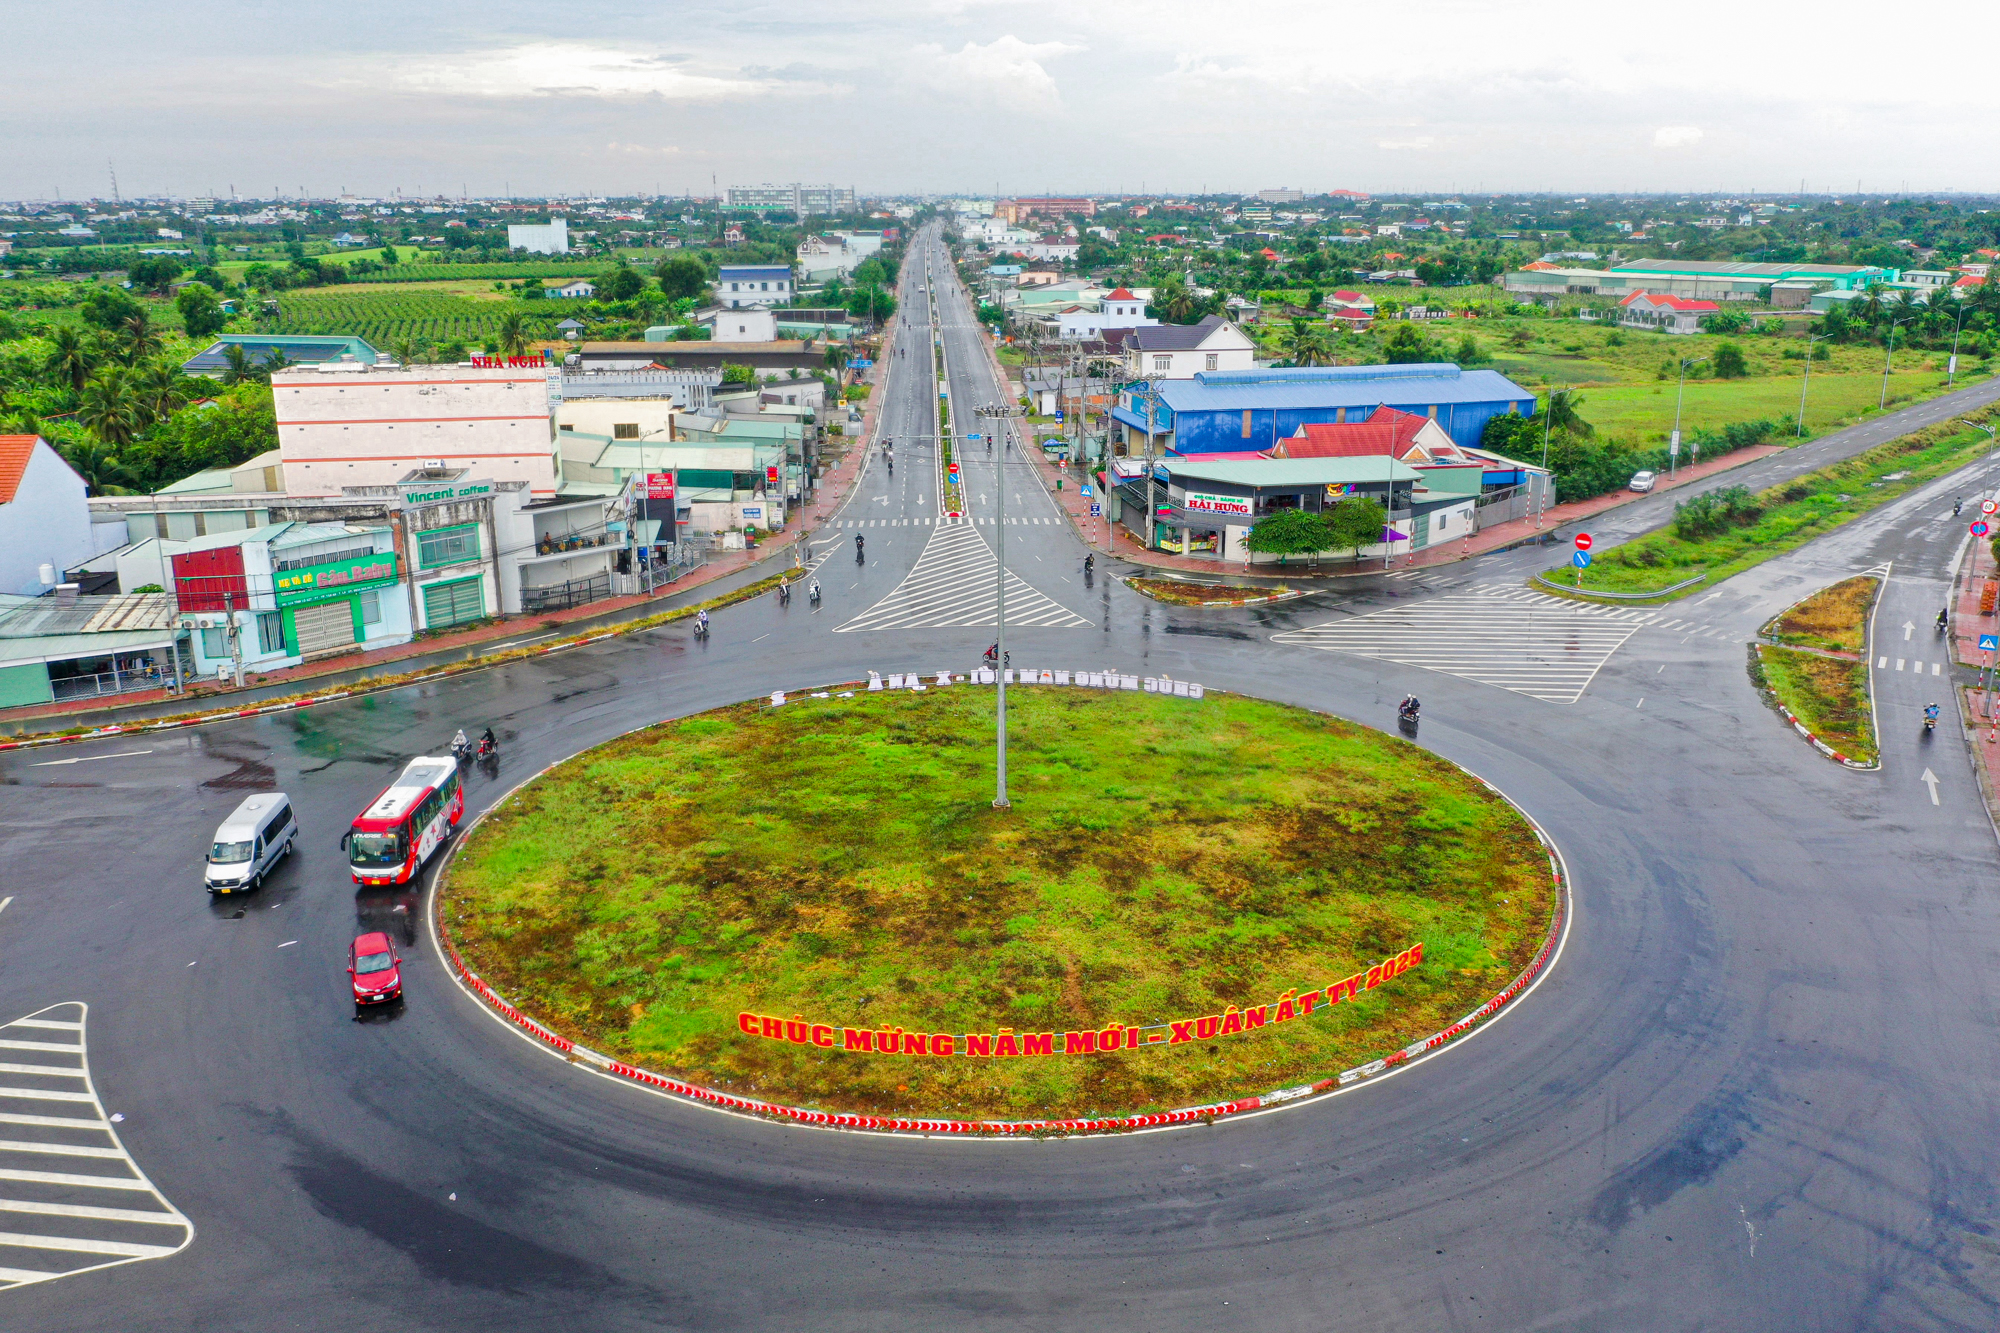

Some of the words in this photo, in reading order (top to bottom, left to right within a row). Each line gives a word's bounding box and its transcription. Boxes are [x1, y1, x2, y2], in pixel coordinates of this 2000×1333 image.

[471, 352, 504, 369] NHÀ
[508, 350, 546, 368] NGHỈ
[406, 487, 454, 504] Vincent
[458, 485, 490, 496] coffee
[1188, 499, 1212, 510] HẢI
[1214, 502, 1249, 513] HƯNG
[278, 578, 291, 589] MẸ
[291, 574, 302, 586] VÀ
[302, 572, 314, 583] BÉ
[738, 1011, 835, 1048] CHÚC
[842, 1023, 955, 1057] MỪNG
[965, 1027, 1054, 1057] NĂM
[1064, 1021, 1140, 1055] MỚI
[1147, 1033, 1162, 1043] -
[1168, 1004, 1268, 1045] XUÂN
[1273, 988, 1320, 1024] ẤT
[1325, 973, 1362, 1003] TỴ
[1365, 942, 1424, 991] 2025
